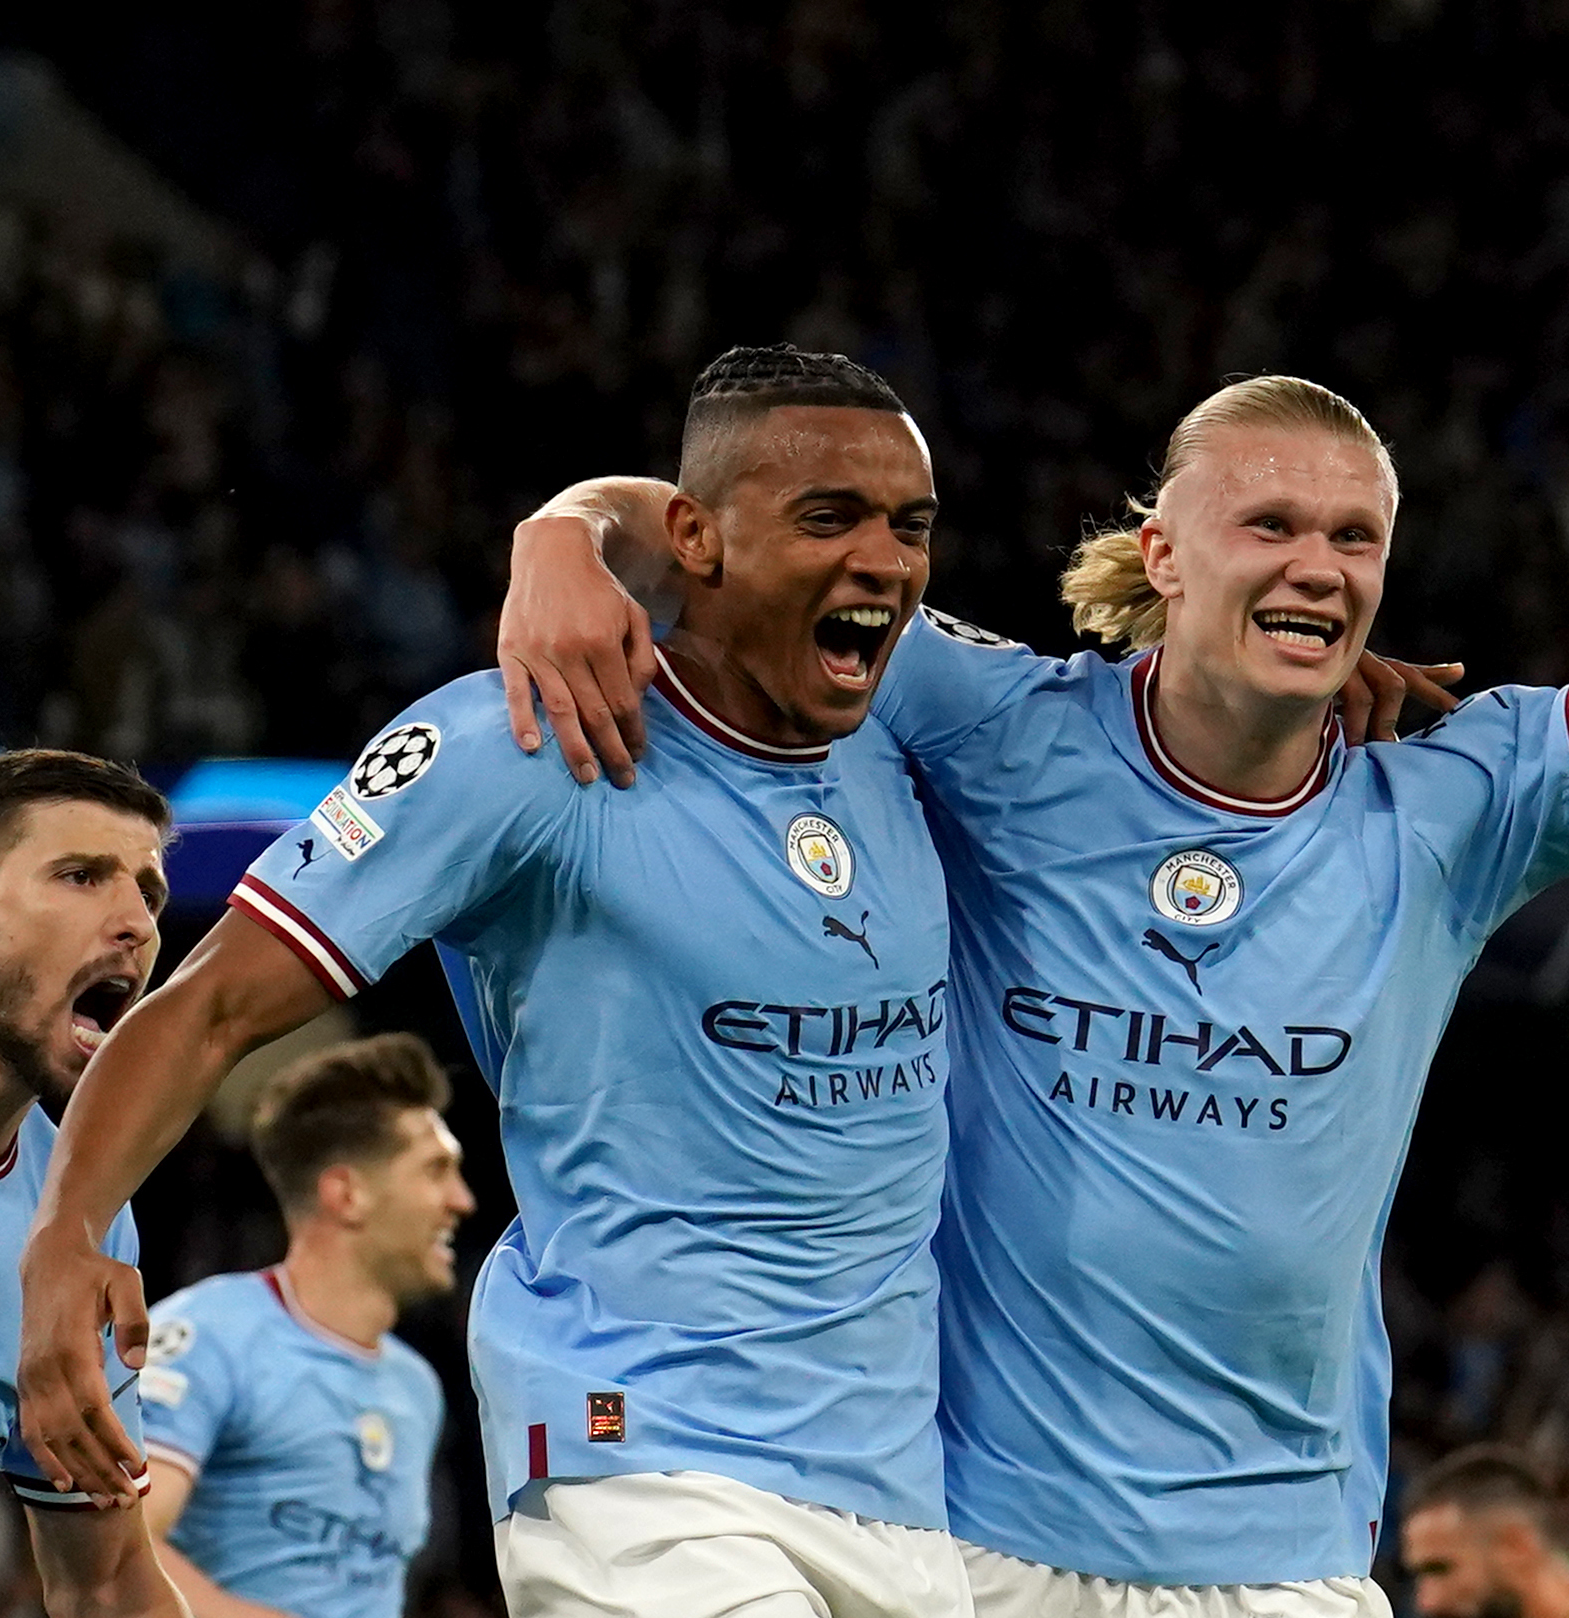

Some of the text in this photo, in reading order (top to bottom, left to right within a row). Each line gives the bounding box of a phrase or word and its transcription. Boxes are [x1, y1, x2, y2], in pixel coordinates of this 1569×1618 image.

[788, 819, 840, 850] MANCHESTER
[1165, 853, 1237, 890] MANCHESTER
[1002, 987, 1353, 1077] ETIHAD
[774, 1052, 937, 1106] AIRWAYS
[1049, 1071, 1289, 1131] AIRWAYS
